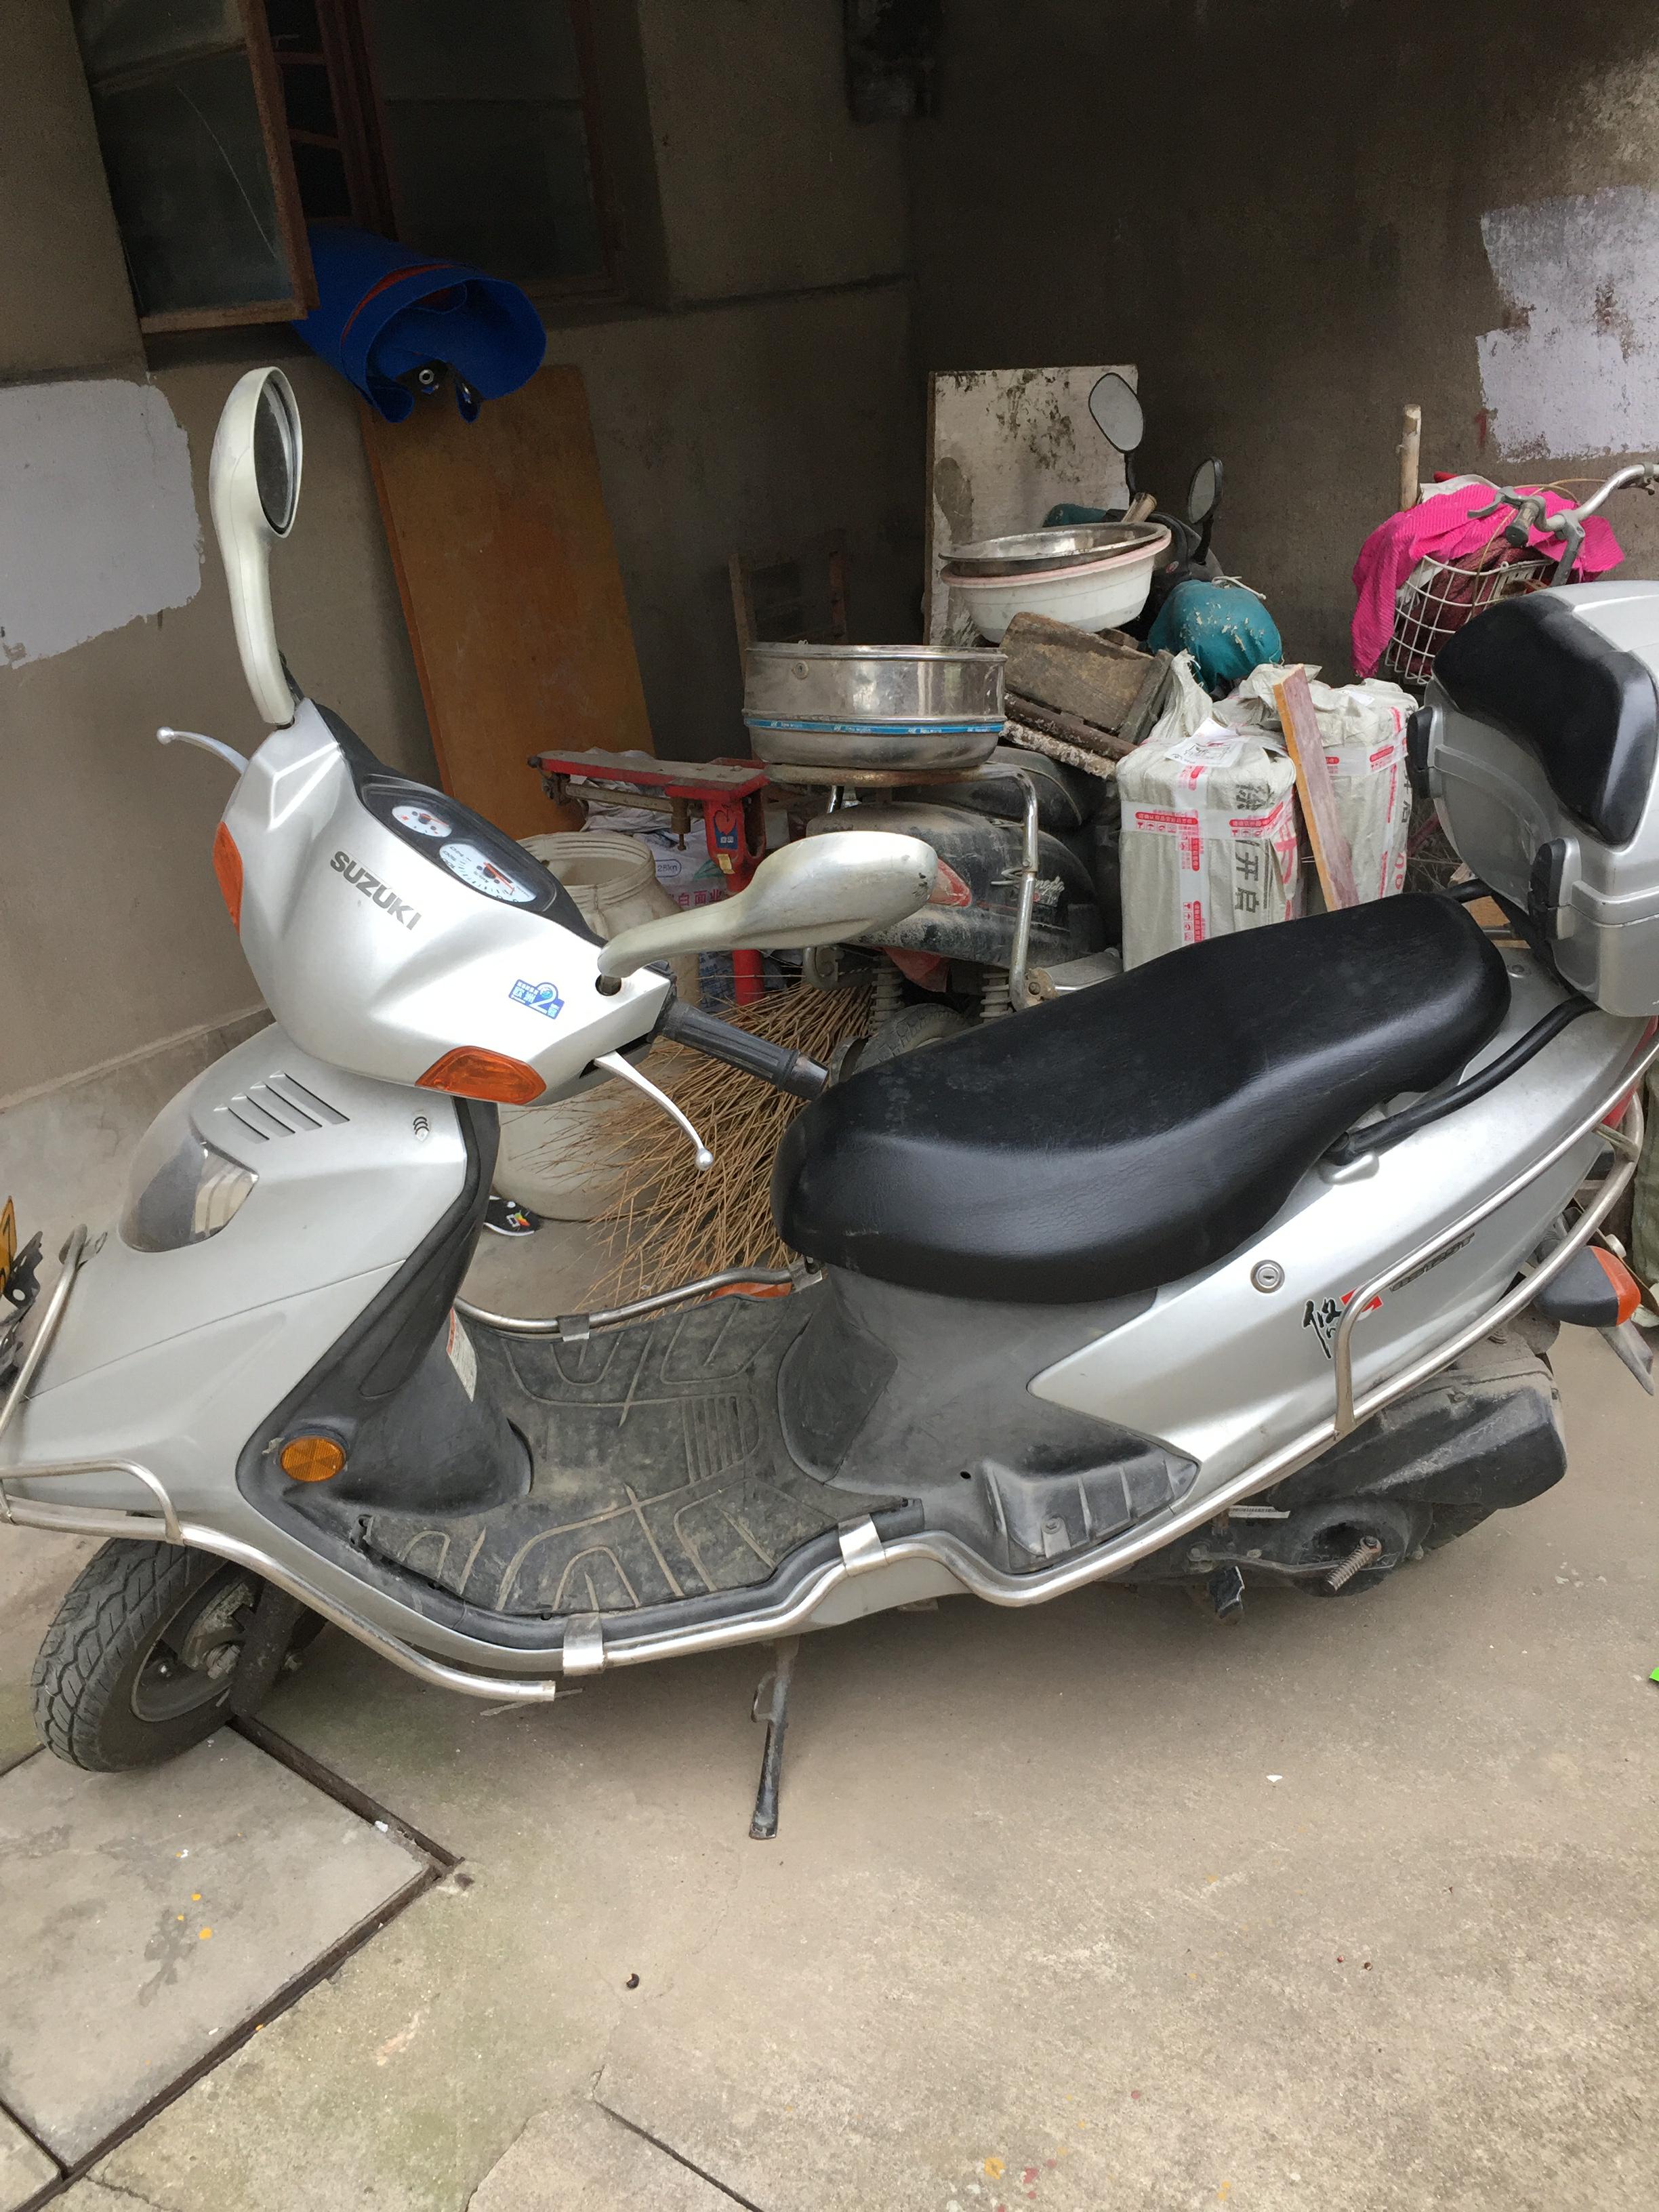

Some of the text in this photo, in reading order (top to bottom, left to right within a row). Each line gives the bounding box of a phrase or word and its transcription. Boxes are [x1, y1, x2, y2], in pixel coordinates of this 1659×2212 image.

[330, 851, 422, 930] SUZUKI
[669, 888, 723, 906] 白面业
